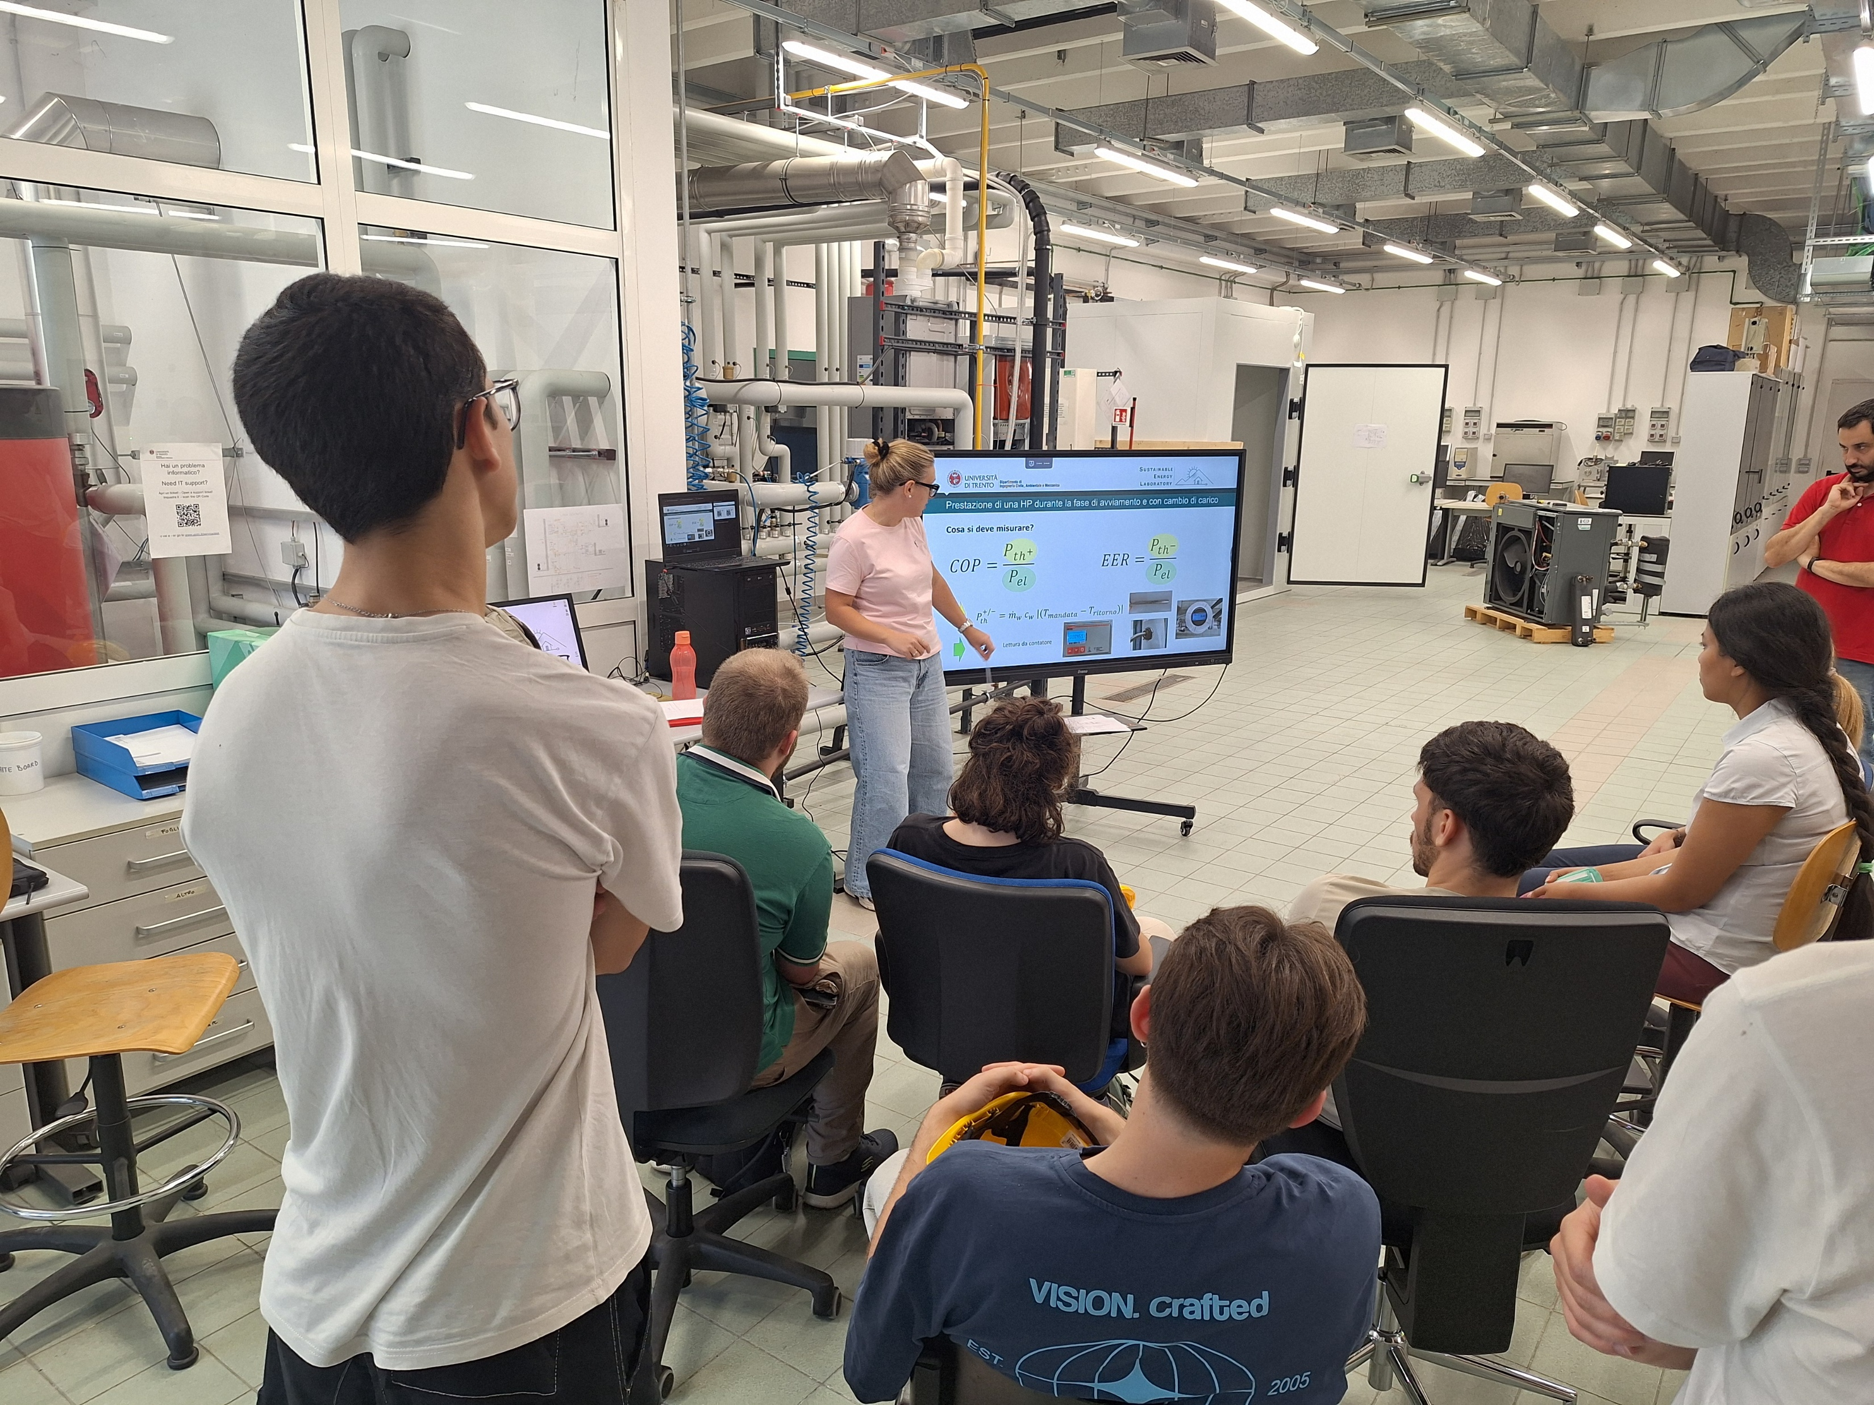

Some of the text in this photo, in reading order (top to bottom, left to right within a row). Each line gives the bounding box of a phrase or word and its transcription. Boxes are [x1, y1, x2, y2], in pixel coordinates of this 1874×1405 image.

[946, 501, 992, 509] Prestazione
[995, 500, 1001, 508] di
[996, 524, 1034, 532] misurare?
[950, 559, 981, 573] COP
[1102, 553, 1129, 567] EER
[17, 761, 38, 771] BOARD
[1029, 1278, 1140, 1319] VISION.
[967, 1339, 1311, 1396] EST. 2005
